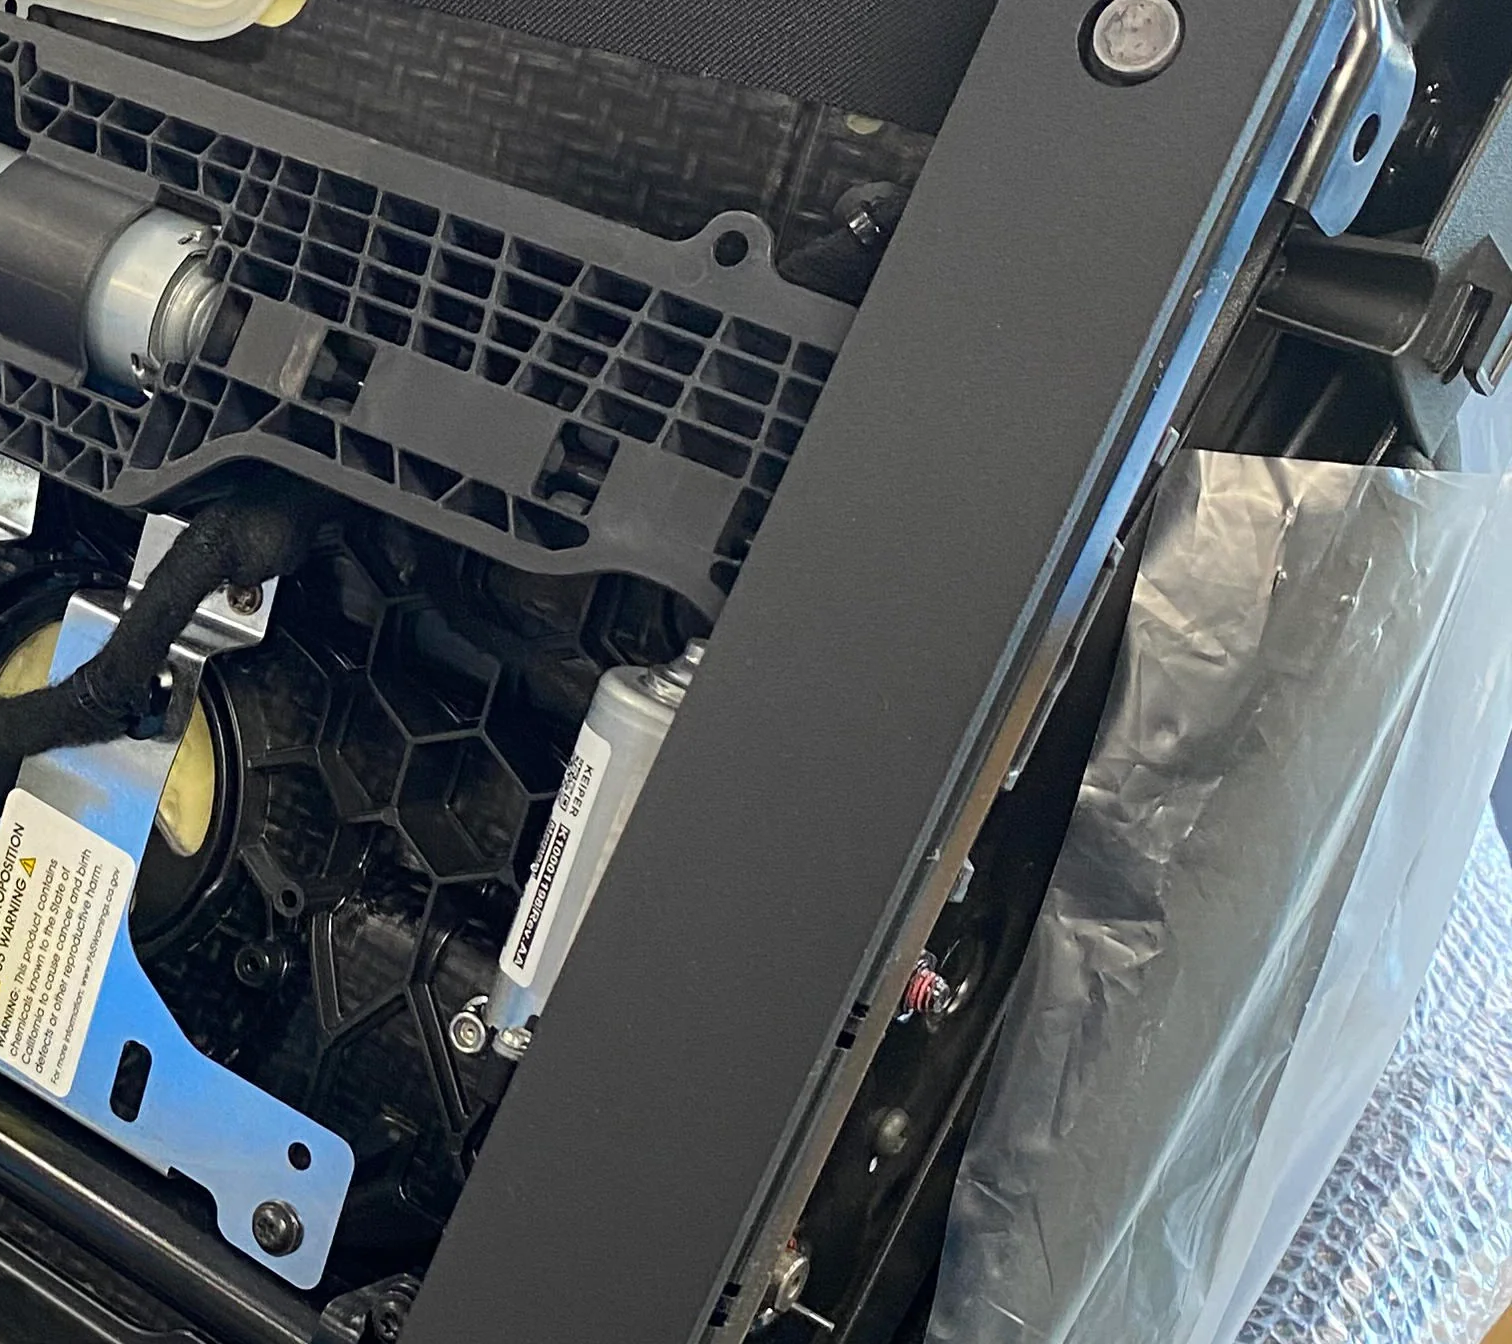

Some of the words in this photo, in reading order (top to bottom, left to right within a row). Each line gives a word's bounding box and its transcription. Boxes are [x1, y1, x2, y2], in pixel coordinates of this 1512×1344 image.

[568, 763, 594, 818] KEIPER
[61, 865, 71, 882] of
[75, 848, 92, 878] birth
[84, 863, 103, 899] harm.
[49, 882, 66, 916] State
[69, 876, 83, 905] and
[13, 962, 28, 985] This
[22, 911, 43, 964] product
[37, 858, 59, 912] contains
[43, 915, 57, 937] the
[55, 905, 75, 952] cancer
[63, 899, 92, 979] reproductive
[38, 938, 50, 953] to
[26, 953, 46, 995] known
[44, 952, 61, 992] cause
[38, 992, 49, 1006] to
[53, 978, 68, 1012] other
[9, 994, 34, 1057] chemicals
[21, 1006, 45, 1065] California
[49, 1011, 58, 1028] or
[34, 1027, 54, 1075] defects
[50, 1068, 61, 1085] For
[56, 1043, 69, 1070] more
